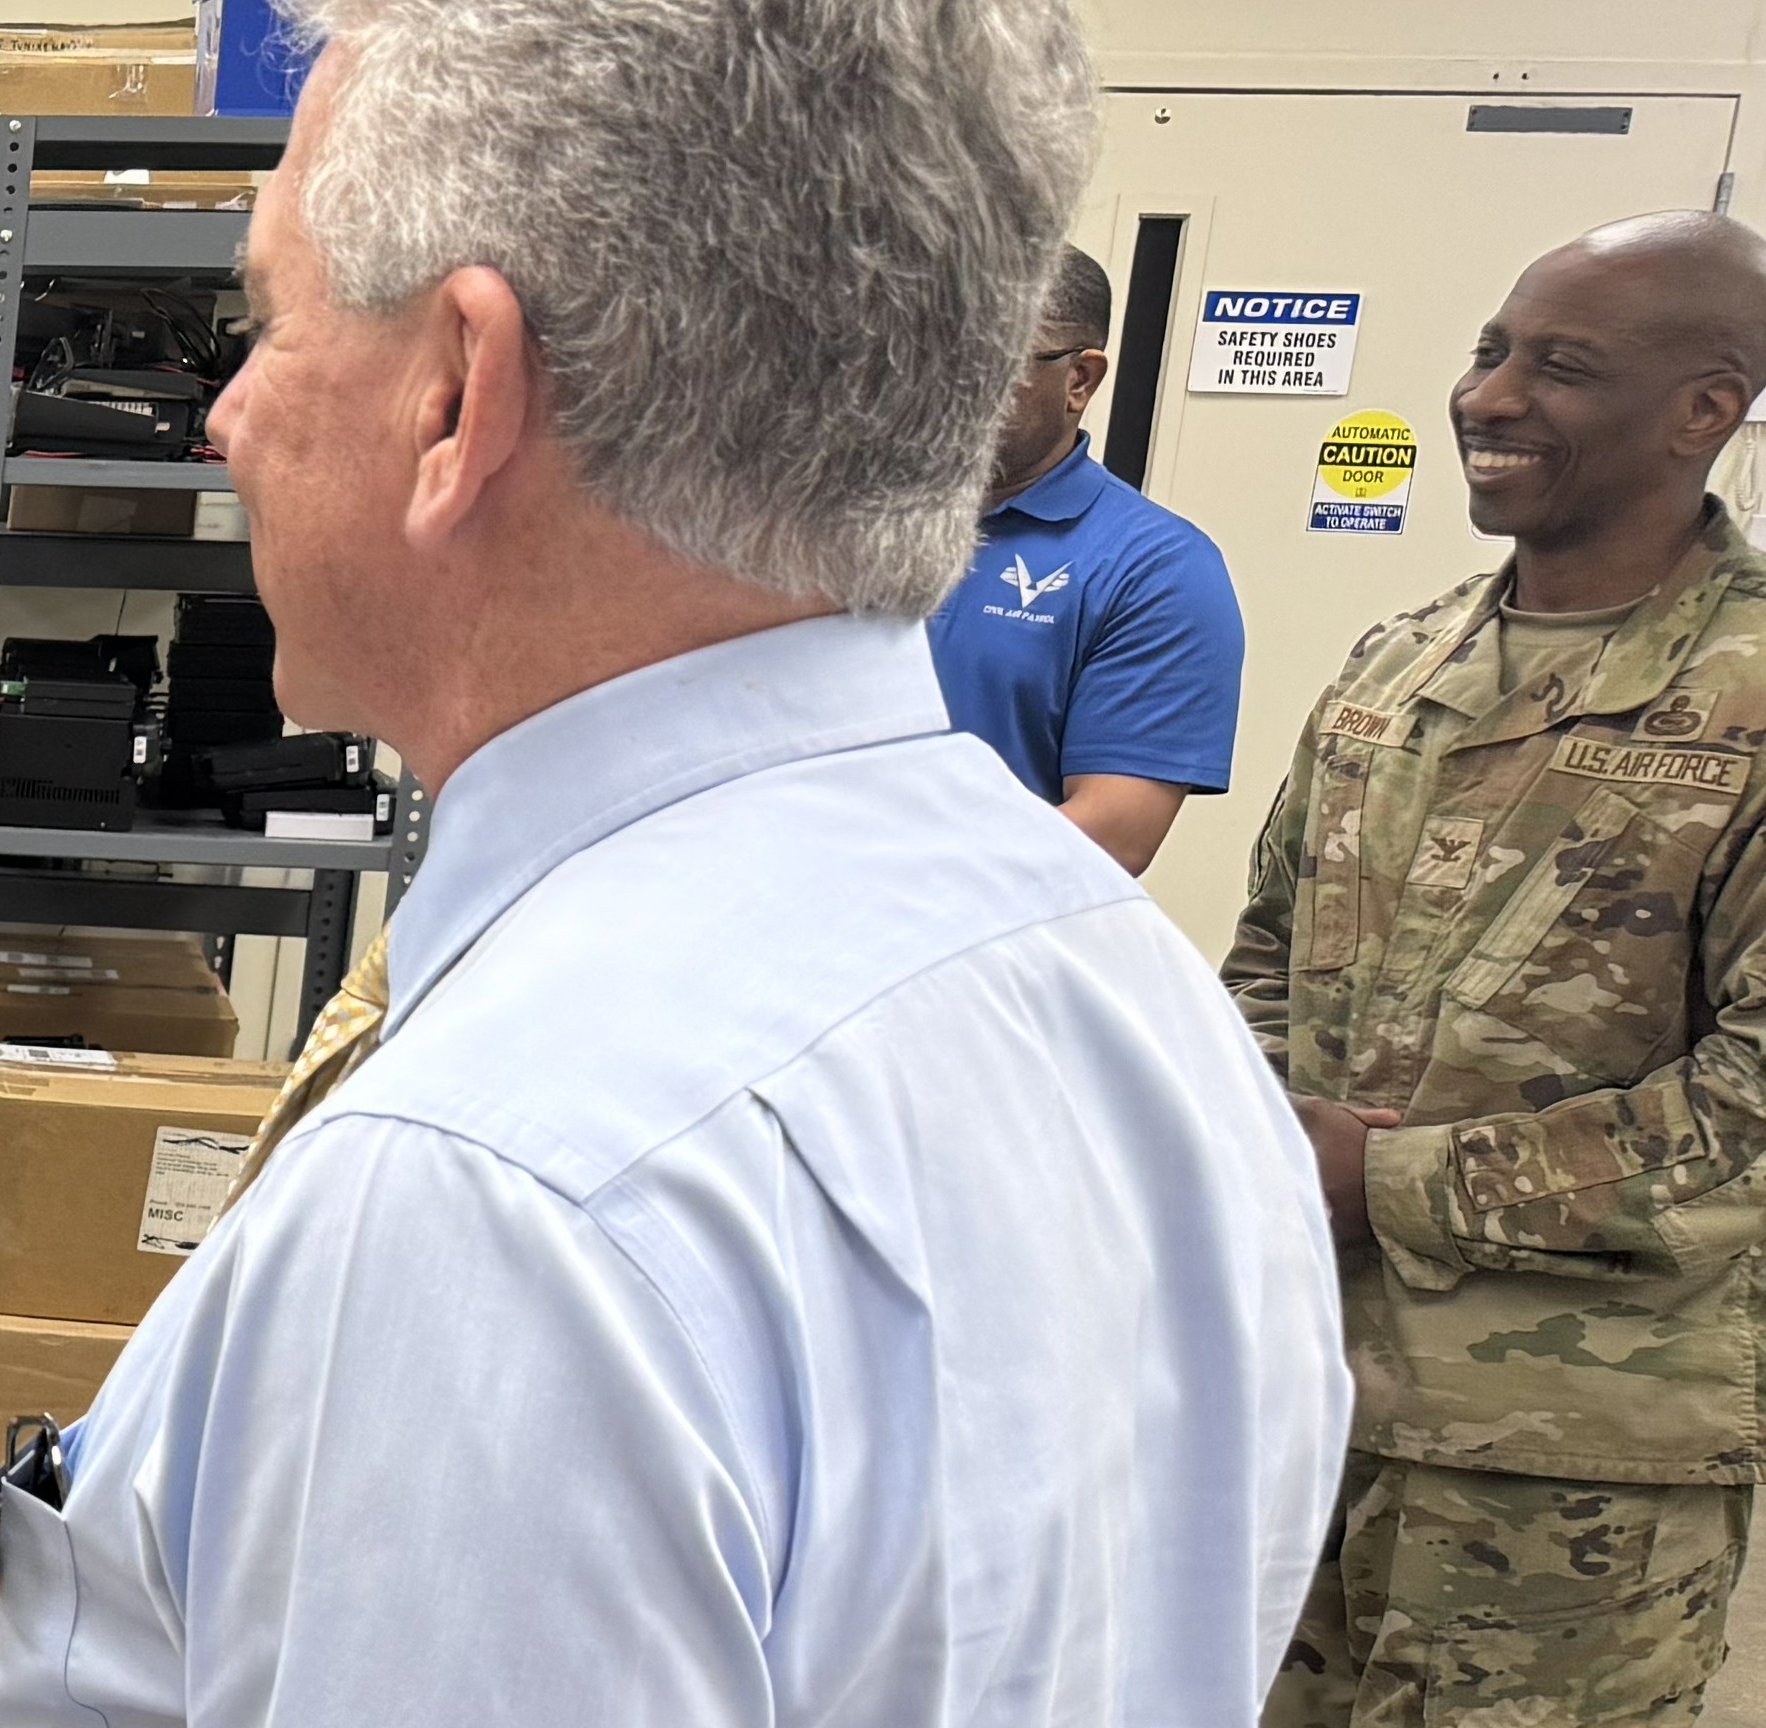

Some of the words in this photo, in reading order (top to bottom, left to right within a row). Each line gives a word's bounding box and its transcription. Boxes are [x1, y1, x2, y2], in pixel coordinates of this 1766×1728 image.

[1214, 297, 1352, 320] NOTICE
[1218, 330, 1278, 347] SAFETY
[1283, 332, 1337, 349] SHOES
[1233, 350, 1315, 368] REQUIRED
[1218, 368, 1234, 385] IN
[1241, 369, 1277, 386] THIS
[1282, 371, 1323, 388] AREA
[1332, 426, 1411, 441] AUTOMATIC
[1323, 445, 1412, 466] CAUTION
[1342, 469, 1384, 483] DOOR
[1314, 504, 1361, 516] ACTIVATE
[1363, 505, 1401, 518] SWITCH
[1326, 516, 1338, 528] TO
[1340, 517, 1387, 530] OPERATE
[1332, 707, 1393, 740] BROWN
[1564, 742, 1609, 775] U.S.
[1611, 750, 1654, 776] AIR
[1653, 752, 1737, 787] FORCE
[147, 1207, 184, 1222] MISC
